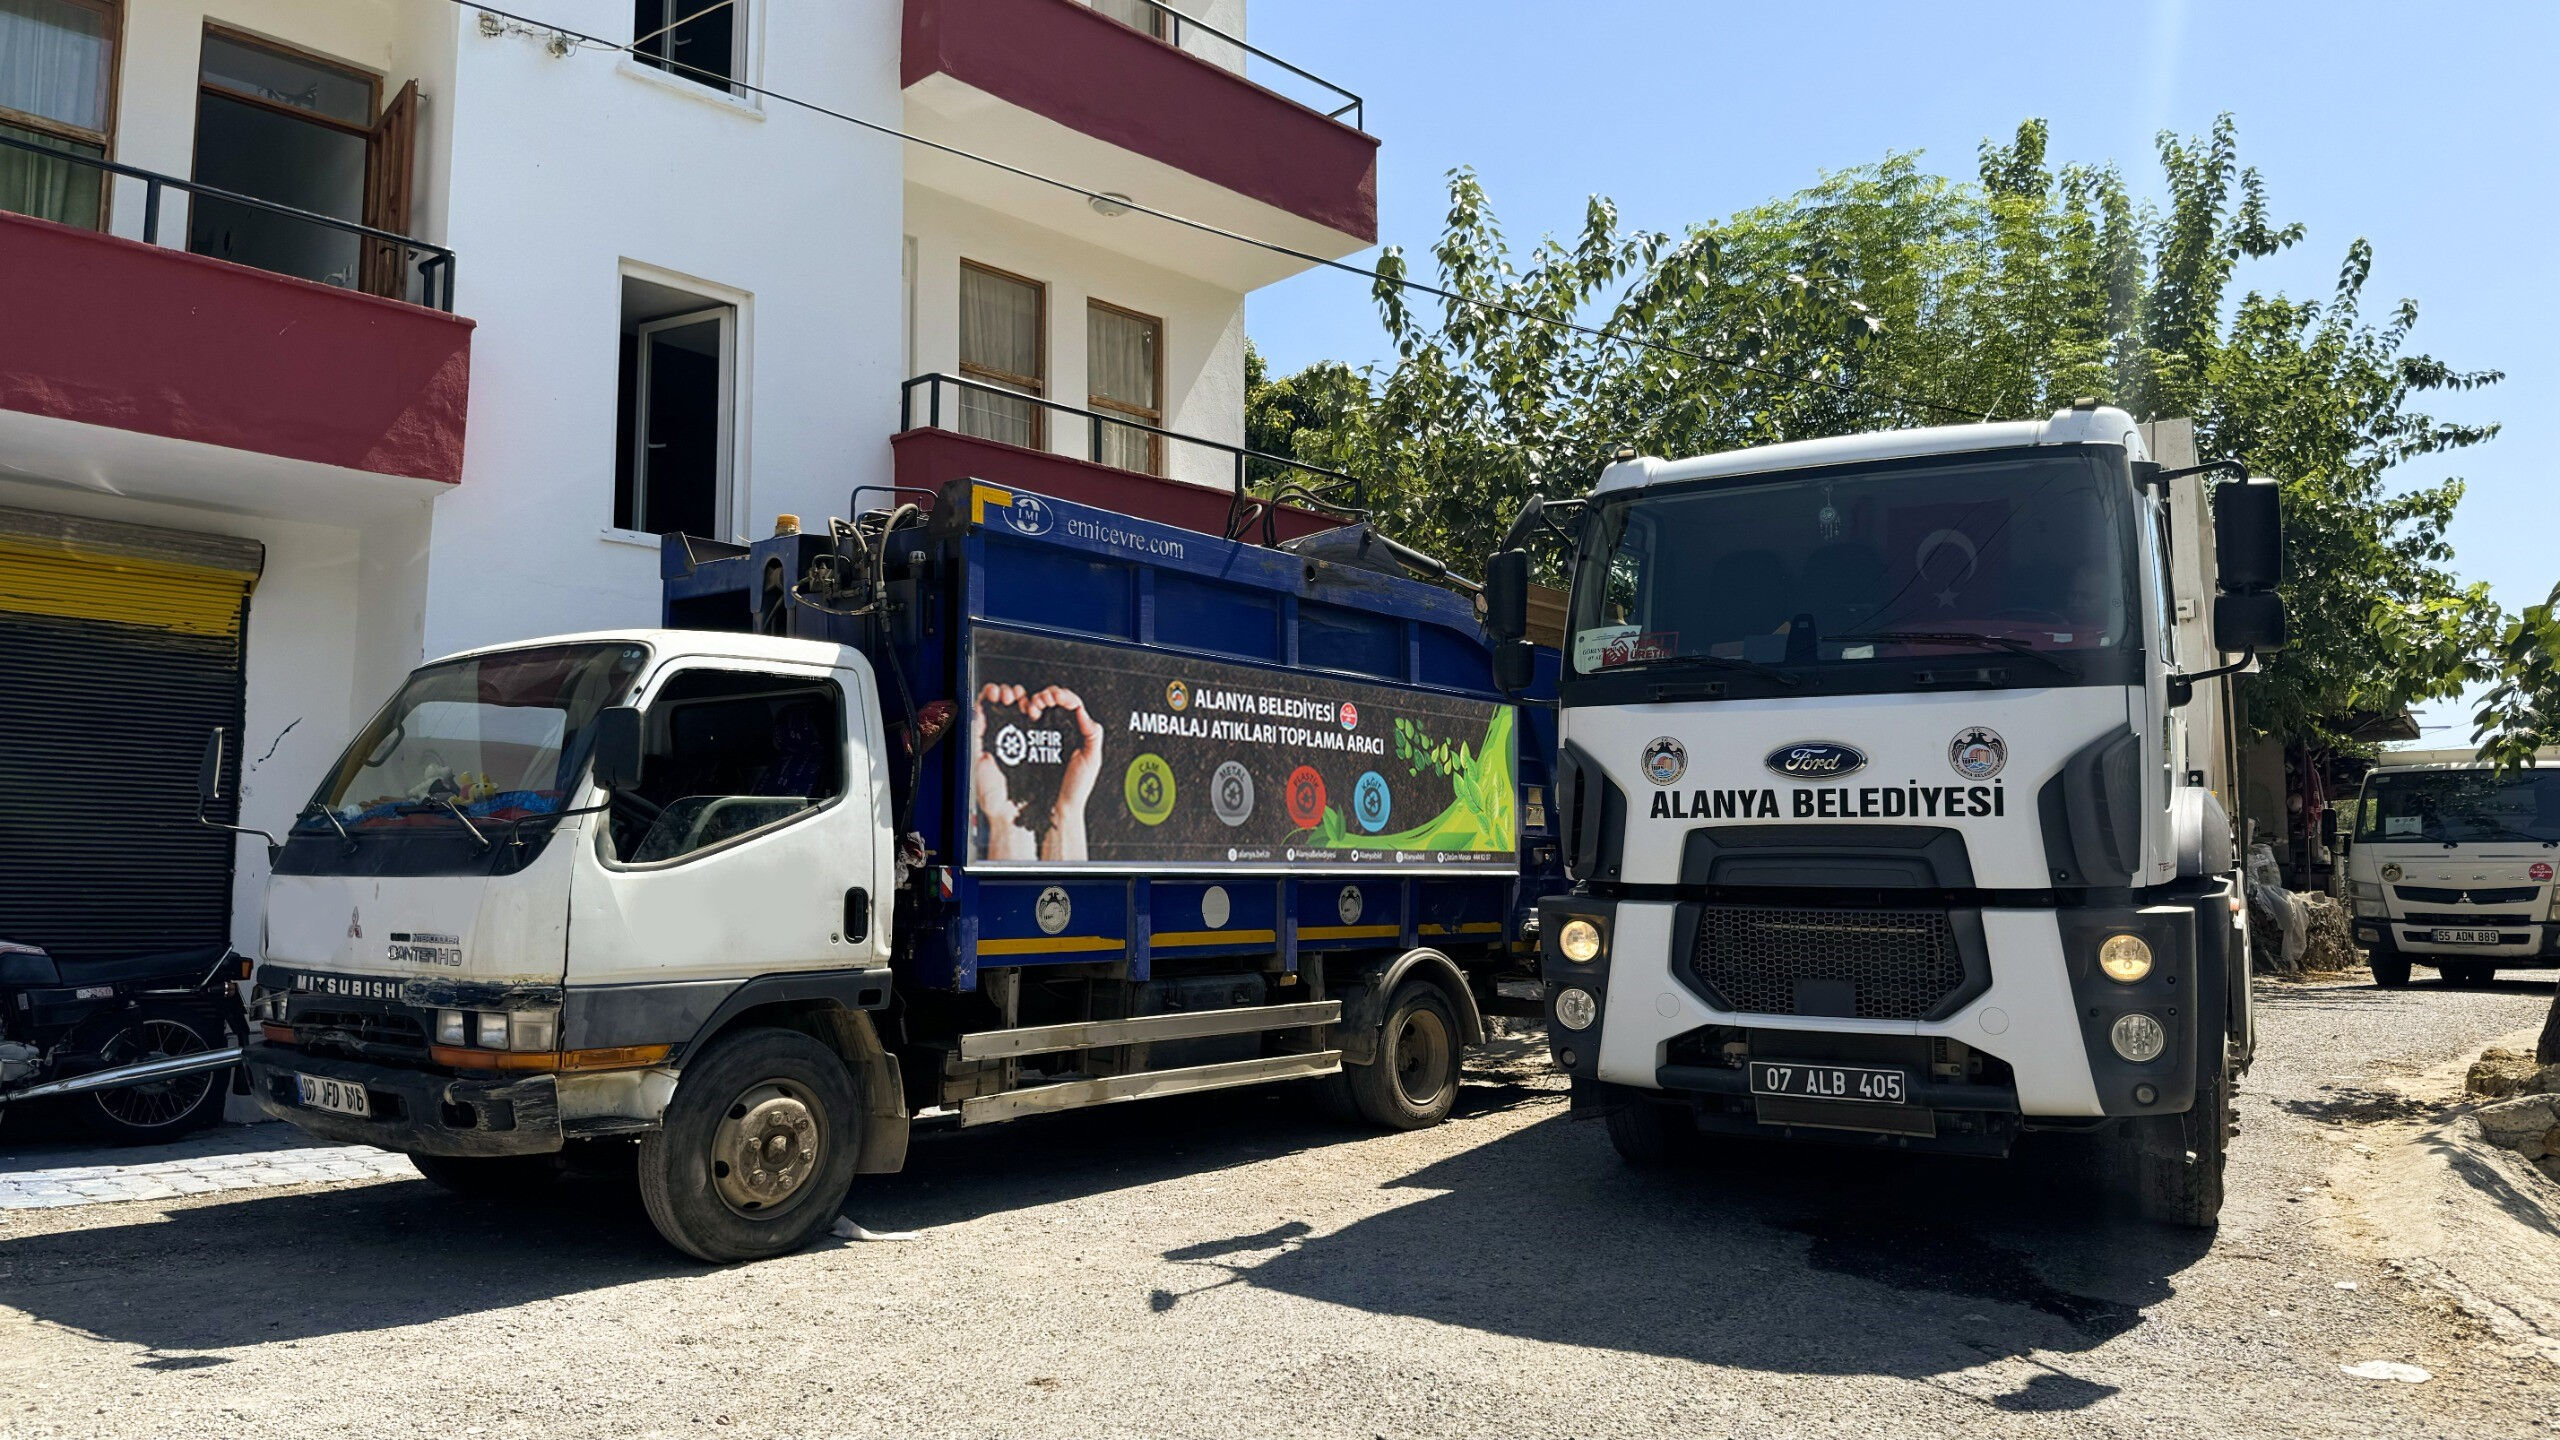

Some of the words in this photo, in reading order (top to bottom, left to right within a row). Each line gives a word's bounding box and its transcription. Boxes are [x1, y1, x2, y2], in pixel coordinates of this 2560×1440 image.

[1068, 517, 1184, 560] emicevre.com
[1195, 688, 1256, 714] ALANYA
[1258, 694, 1335, 723] BELEDİYESİ
[1026, 729, 1063, 746] SIFIR
[1129, 711, 1208, 738] AMBALAJ
[1211, 720, 1277, 745] ATIKLARI
[1279, 727, 1345, 751] TOPLAMA
[1347, 734, 1385, 756] ARACI
[1028, 747, 1063, 765] ATIK
[1785, 748, 1841, 771] Ford
[1219, 766, 1246, 782] METAL
[1650, 789, 1780, 819] ALANYA
[1793, 778, 2004, 819] BELEDİYESİ
[2438, 931, 2451, 941] 55
[2456, 931, 2475, 942] ADN
[2478, 932, 2497, 942] 889
[297, 974, 404, 999] MITSUBISHI
[302, 1077, 316, 1103] 07
[344, 1085, 364, 1112] 616
[1766, 1067, 1792, 1092] 07
[1806, 1069, 1846, 1096] ALB
[1859, 1073, 1901, 1100] 405
